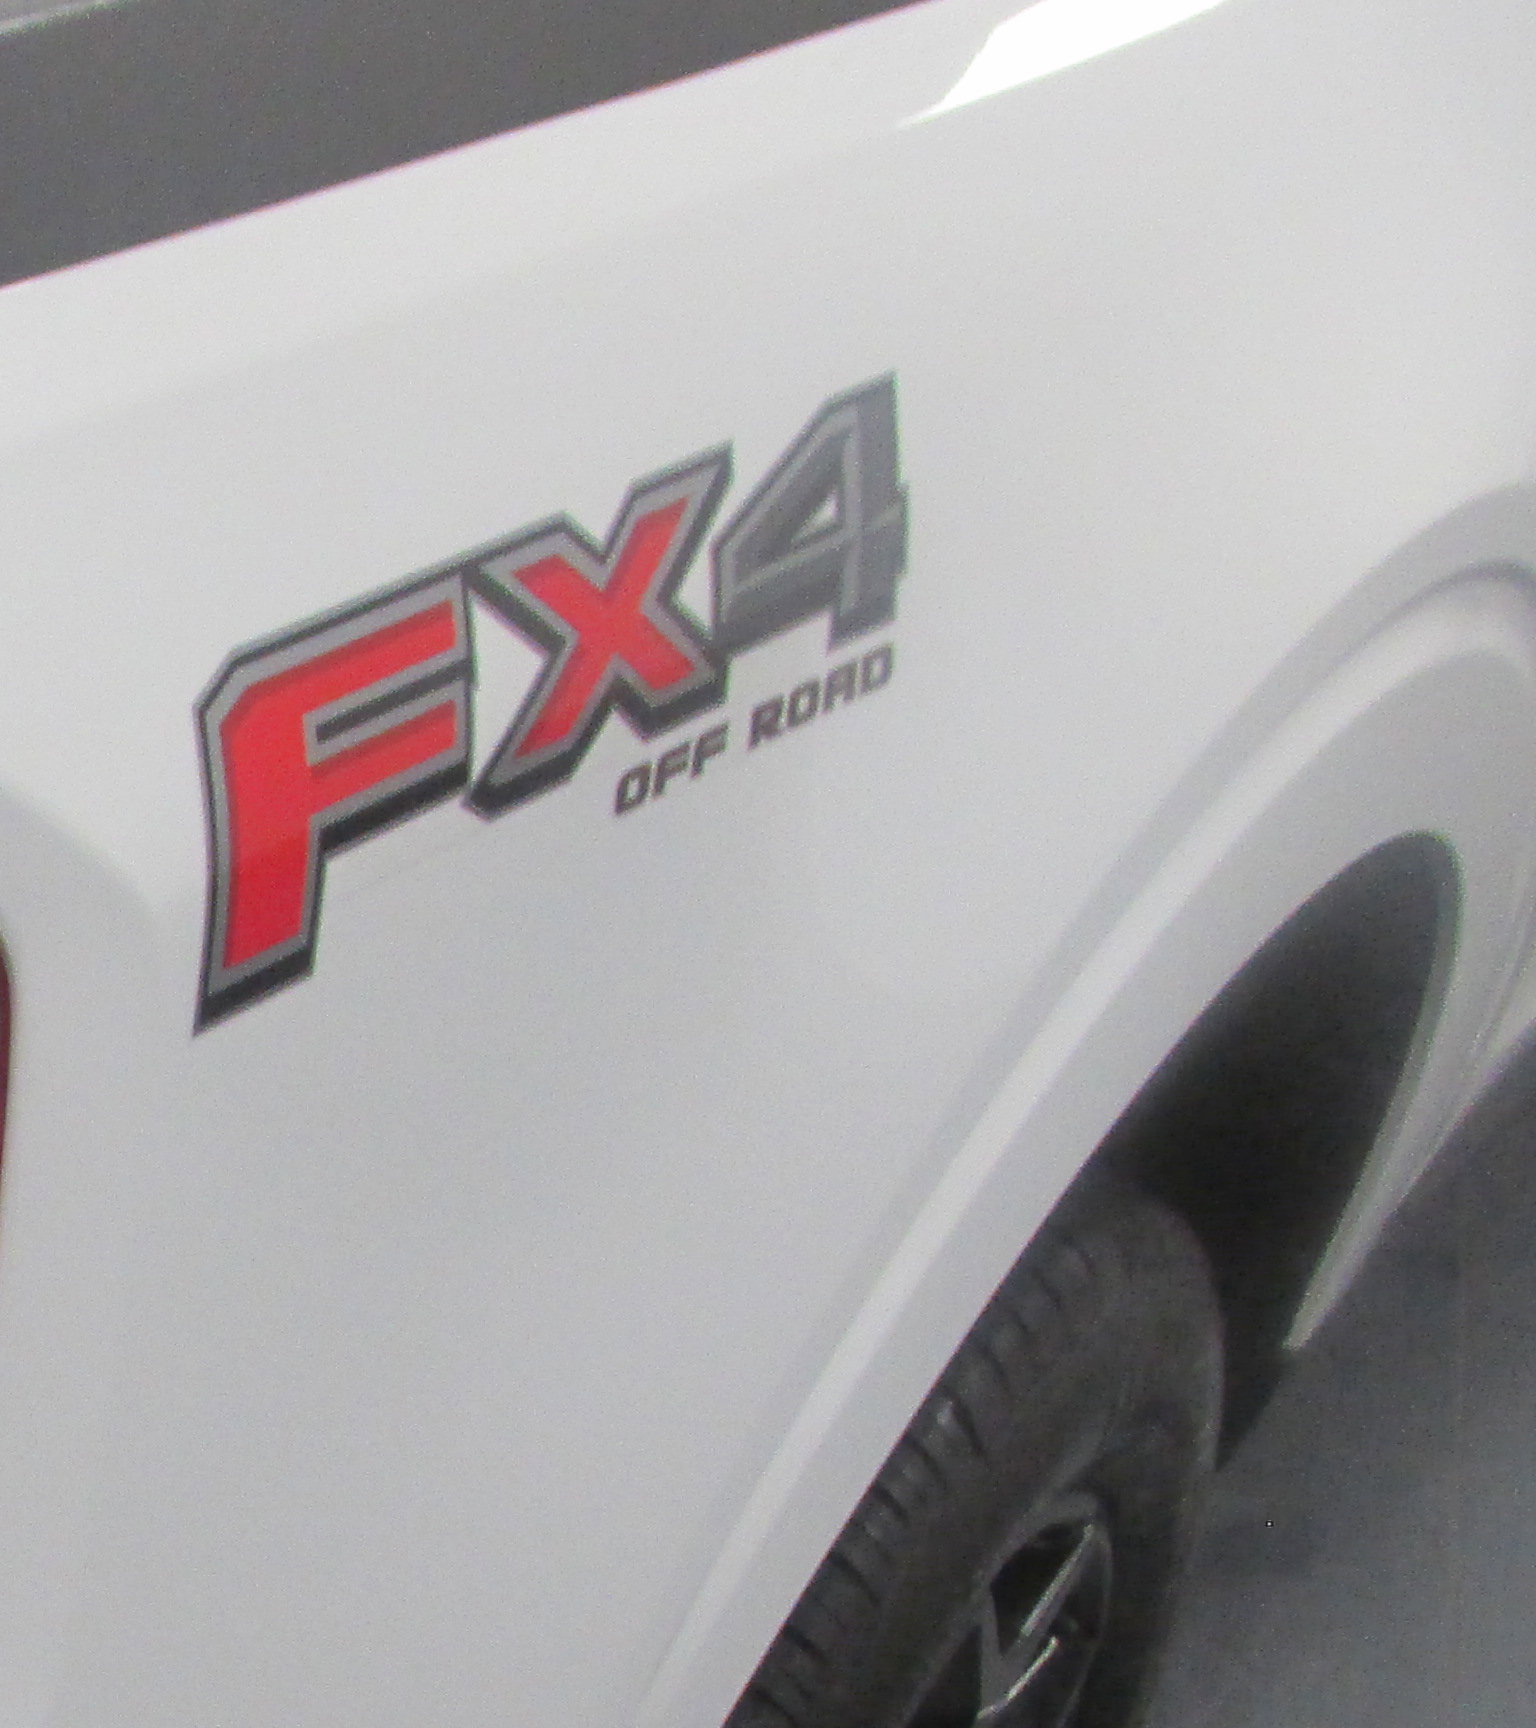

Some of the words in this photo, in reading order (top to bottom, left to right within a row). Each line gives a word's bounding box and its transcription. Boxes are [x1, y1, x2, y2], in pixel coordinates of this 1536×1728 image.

[192, 369, 910, 1037] FX4
[614, 724, 729, 817] OFF
[746, 642, 895, 752] ROAD
